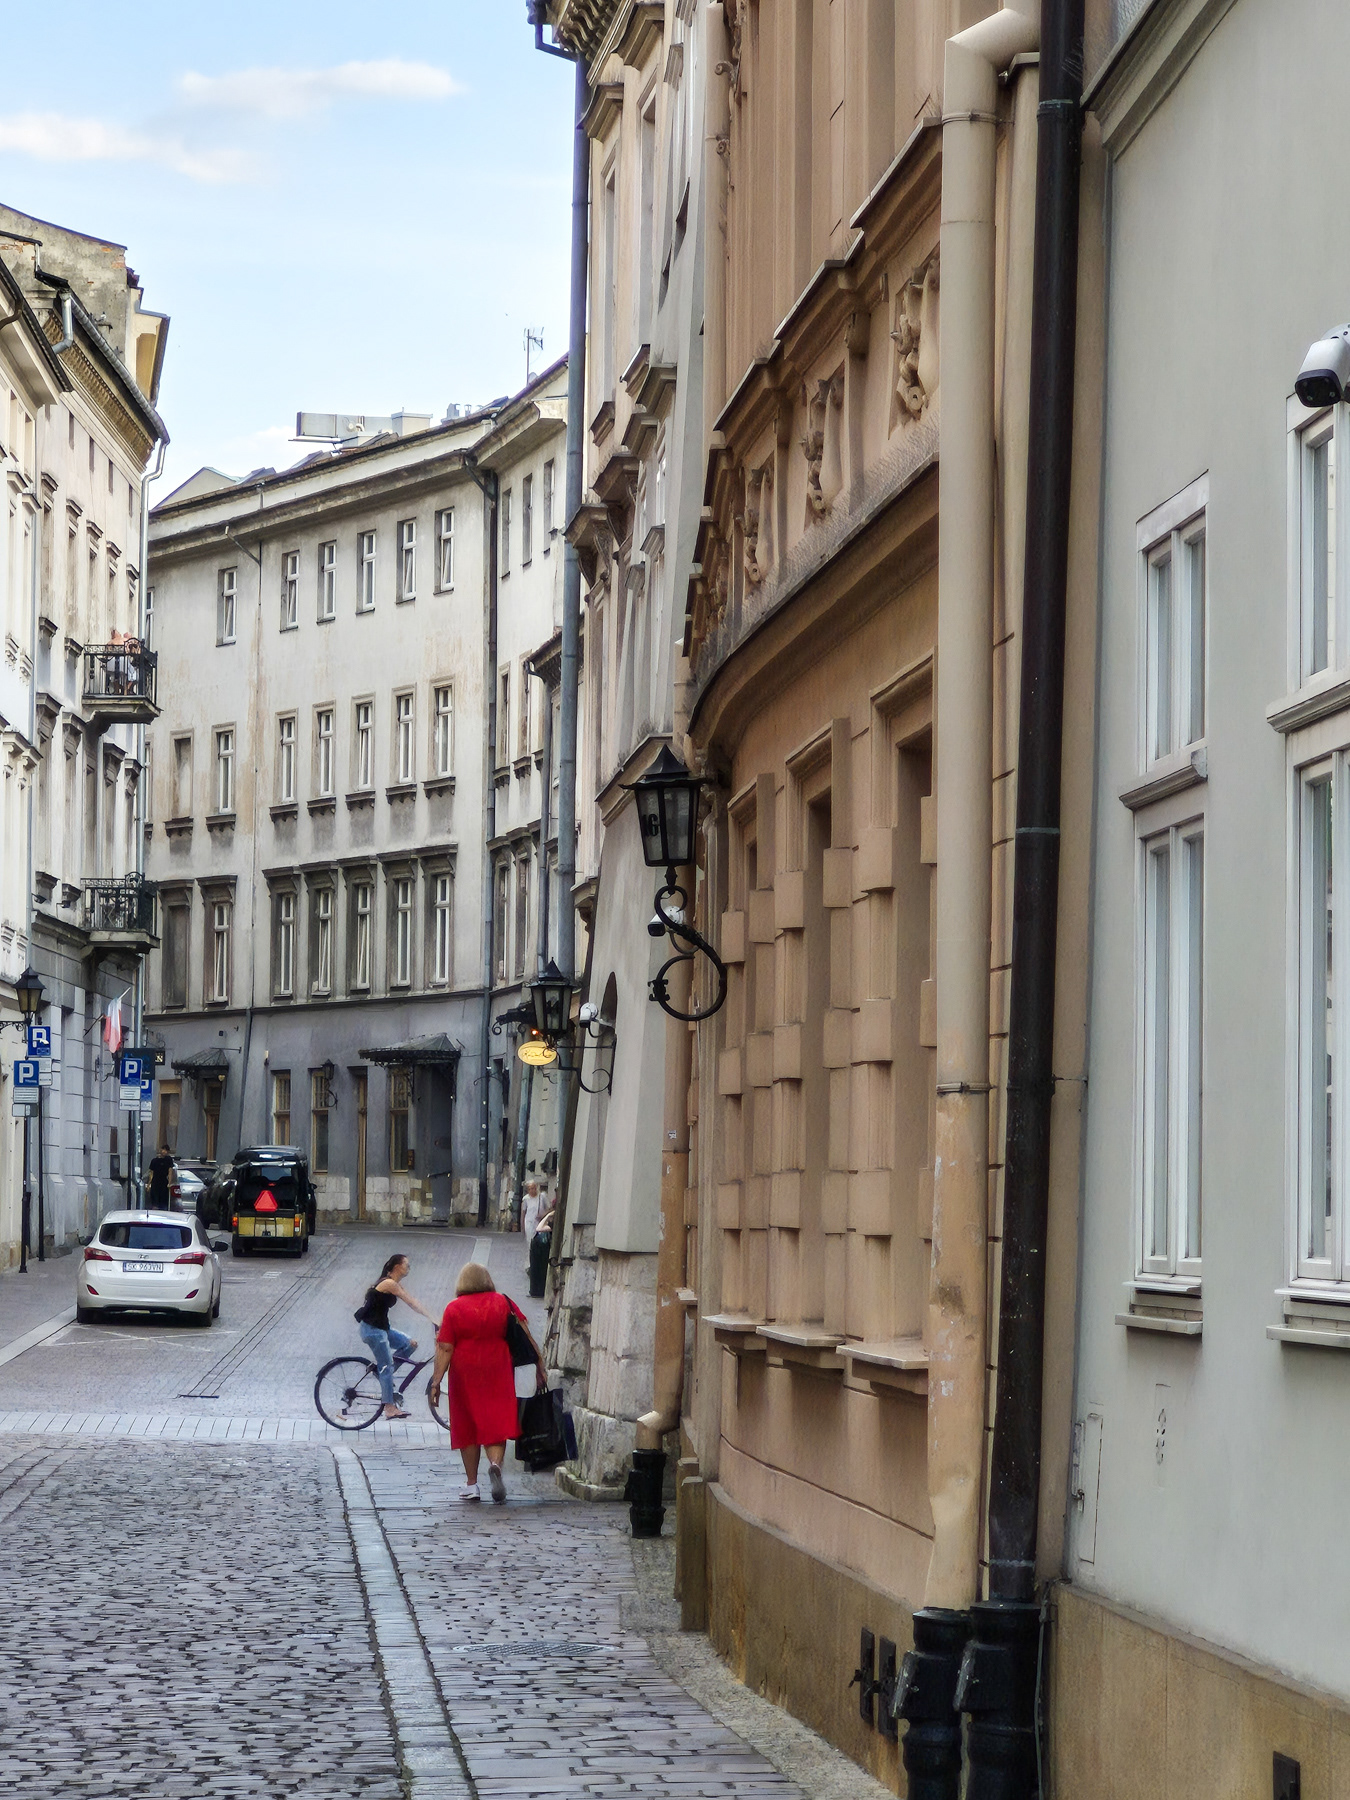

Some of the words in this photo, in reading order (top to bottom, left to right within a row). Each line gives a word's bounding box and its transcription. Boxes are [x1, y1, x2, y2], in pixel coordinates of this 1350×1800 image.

[32, 1028, 46, 1048] P
[19, 1062, 34, 1084] P
[124, 1060, 138, 1078] P
